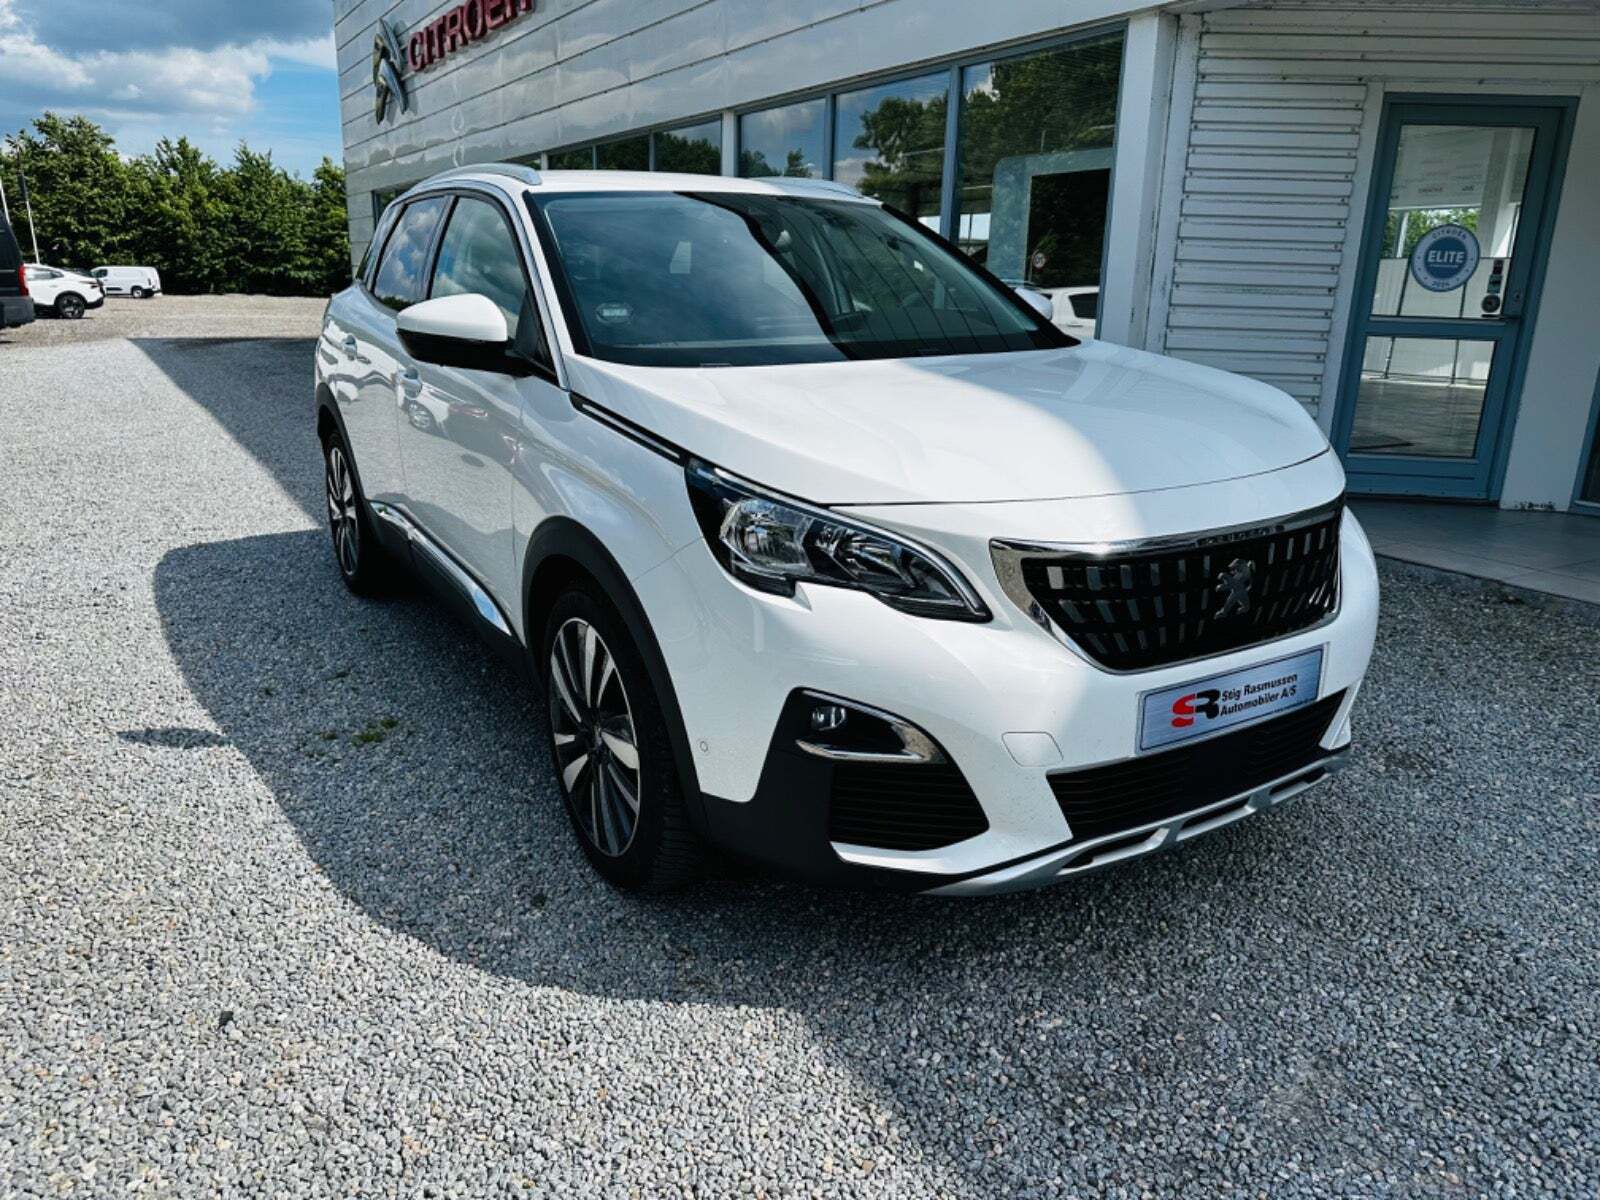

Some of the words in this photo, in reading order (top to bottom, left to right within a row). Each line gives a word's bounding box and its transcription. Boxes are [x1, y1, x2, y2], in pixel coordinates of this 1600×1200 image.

[1428, 250, 1465, 263] ELITE
[1220, 692, 1279, 717] Automobiler
[1280, 685, 1297, 699] A/S
[1221, 689, 1242, 702] Stig
[1243, 674, 1298, 696] Rasmussen
